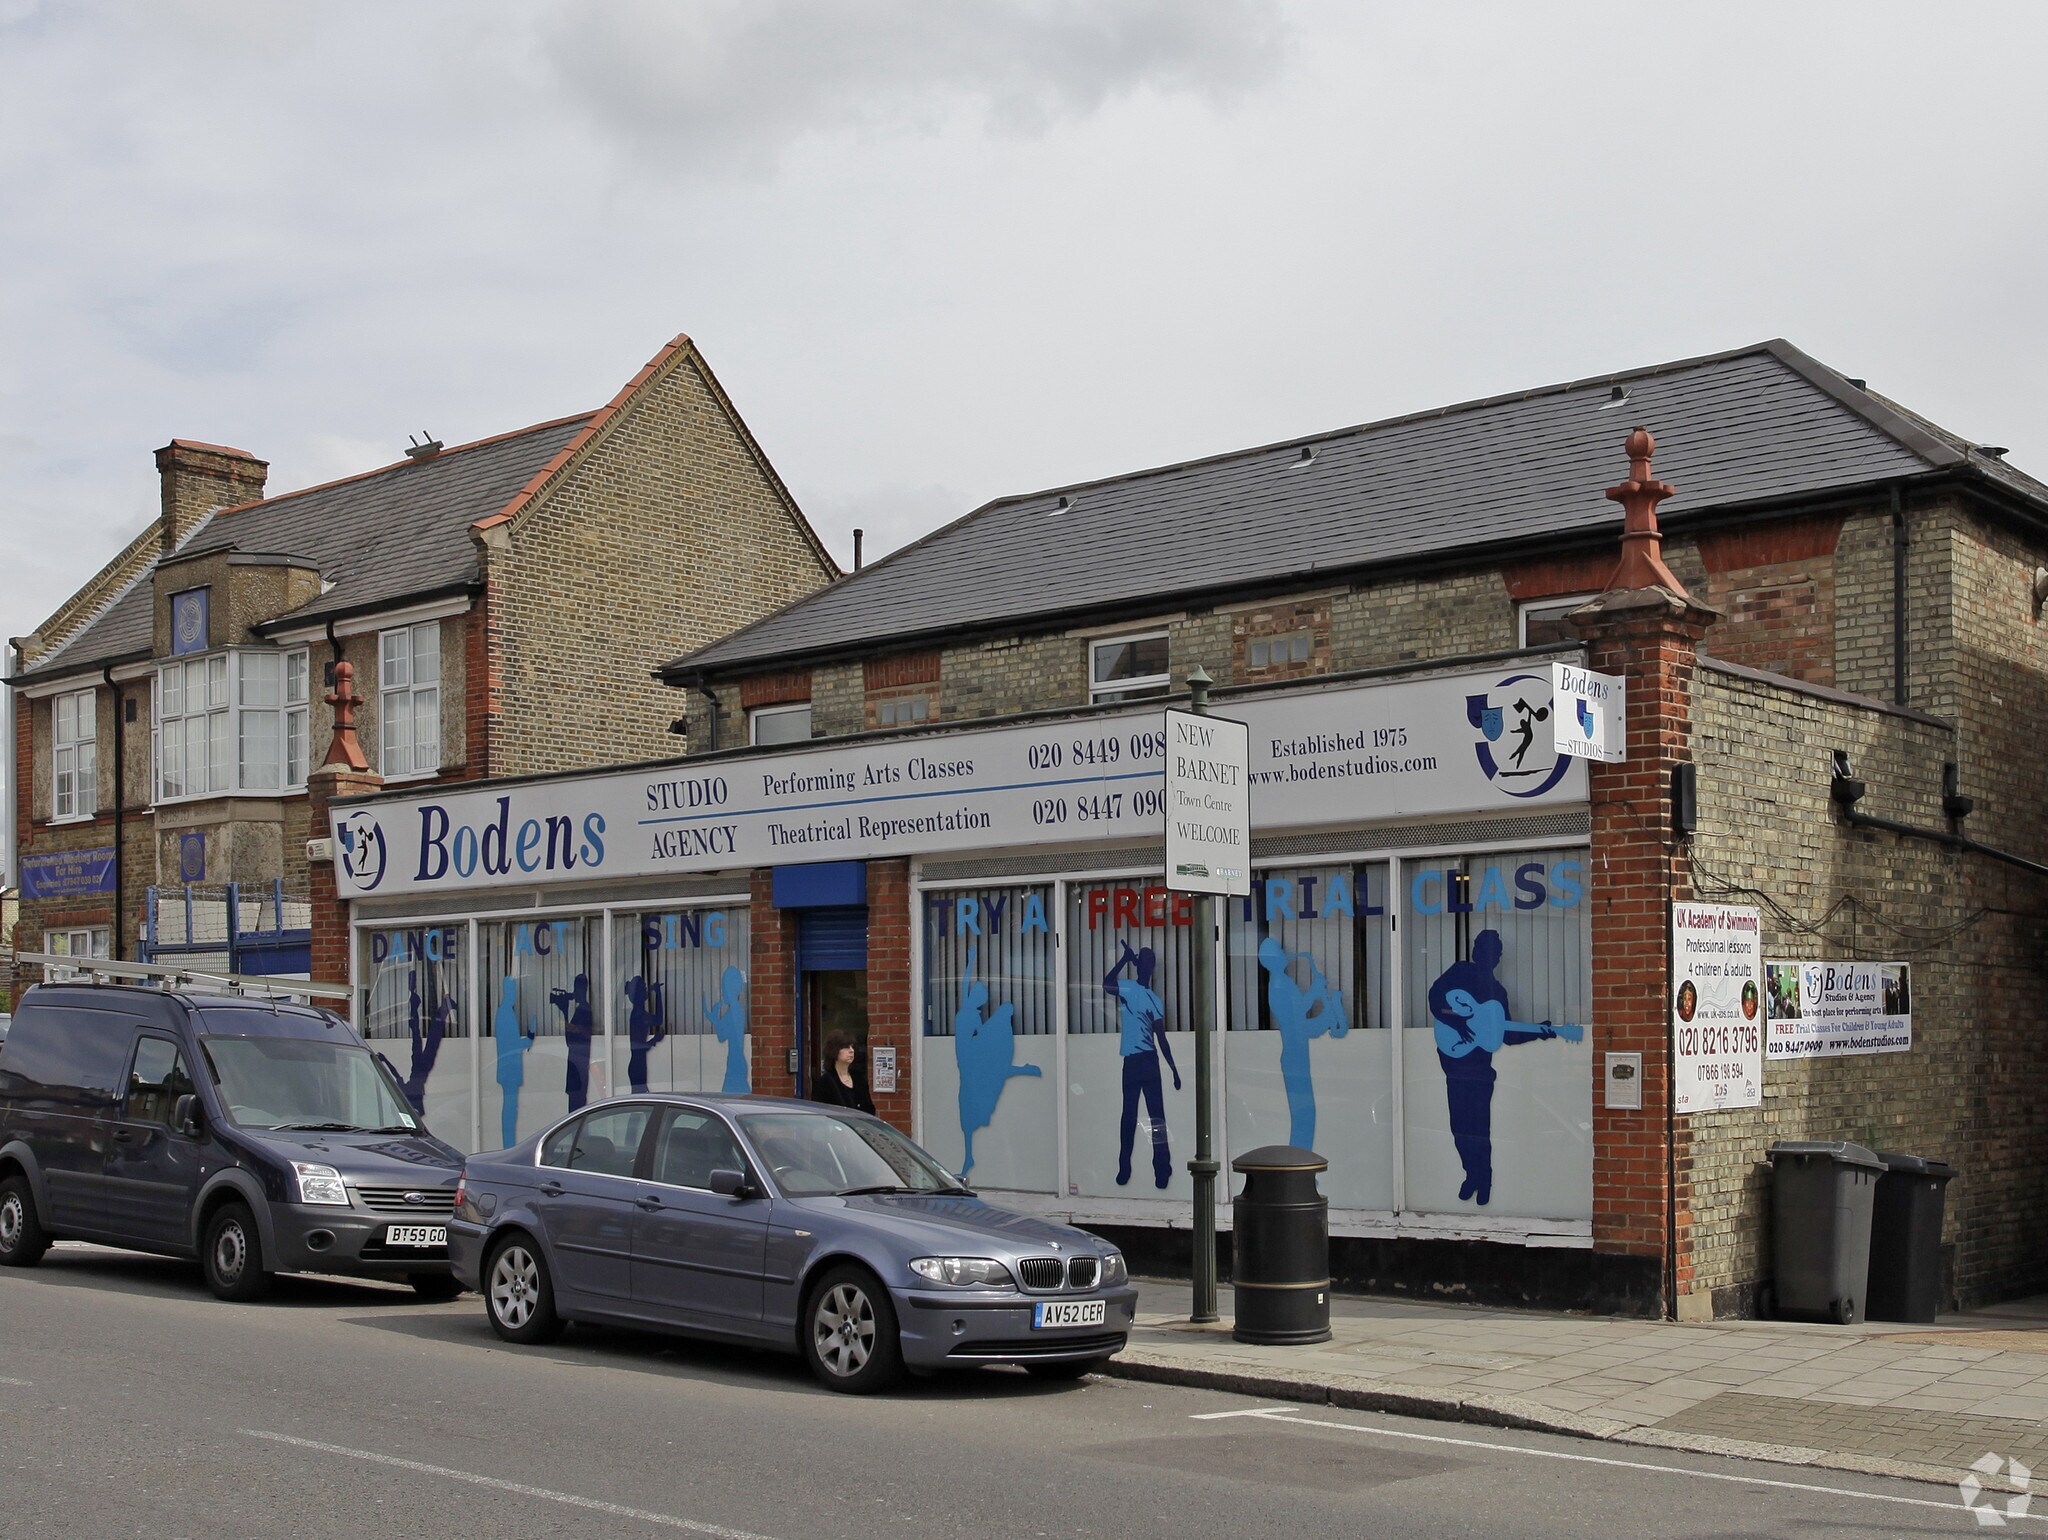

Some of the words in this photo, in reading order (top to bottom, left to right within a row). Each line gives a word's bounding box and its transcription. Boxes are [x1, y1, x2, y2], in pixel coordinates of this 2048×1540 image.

[1560, 667, 1609, 700] Bodens
[1176, 722, 1215, 748] NEW
[1271, 730, 1365, 759] Established
[1372, 727, 1408, 748] 1975
[1567, 739, 1603, 759] STUDIOS
[1028, 744, 1063, 771] 020
[1072, 736, 1120, 767] 8449
[1130, 731, 1165, 760] 098
[763, 768, 856, 796] Performing
[862, 763, 900, 786] Arts
[908, 757, 974, 781] Classes
[1176, 756, 1240, 786] BARNET
[1248, 754, 1438, 786] www.bodenstudios.com
[646, 776, 728, 811] STUDIO
[1032, 799, 1067, 826] 020
[1077, 793, 1123, 822] 8447
[1133, 788, 1165, 817] 090
[1176, 790, 1201, 807] Town
[1204, 793, 1232, 812] Centre
[413, 796, 606, 882] Bodens
[767, 818, 852, 846] Theatrical
[857, 807, 991, 840] Representation
[1176, 821, 1241, 846] WELCOME
[651, 825, 739, 860] AGENCY
[931, 895, 1007, 937] TRY
[1021, 894, 1049, 934] A
[1088, 886, 1195, 930] FREE
[1411, 860, 1584, 916] CLASS
[645, 911, 726, 951] SING
[1677, 908, 1687, 928] UK
[1688, 909, 1717, 934] Academy
[1718, 910, 1725, 930] of
[1726, 911, 1758, 936] Swimming
[372, 928, 456, 963] DANCE
[514, 921, 569, 956] ACT
[1686, 938, 1726, 953] Professional
[1727, 940, 1752, 954] lessons
[1688, 962, 1693, 976] 4
[1694, 962, 1722, 977] children
[1724, 962, 1729, 977] &
[1730, 963, 1752, 977] adults
[1824, 966, 1877, 991] Bodens
[1802, 1008, 1811, 1017] the
[1811, 1007, 1822, 1016] best
[1822, 1007, 1836, 1018] place
[1836, 1007, 1844, 1016] for
[1845, 1006, 1872, 1018] performing
[1872, 1007, 1882, 1015] arts
[1825, 992, 1847, 1002] Studios
[1848, 992, 1854, 1001] &
[1854, 993, 1876, 1003] Agency
[1679, 1027, 1699, 1056] 020
[1702, 1026, 1729, 1055] 8216
[1732, 1025, 1758, 1054] 3796
[1775, 1024, 1794, 1035] FREE
[1796, 1023, 1811, 1034] Trial
[1811, 1022, 1830, 1033] Classes
[1831, 1022, 1841, 1033] For
[1842, 1021, 1864, 1032] Children
[1870, 1020, 1887, 1032] Young
[1887, 1020, 1904, 1030] Adults
[1769, 1043, 1782, 1053] 020
[1829, 1035, 1909, 1050] www.bodenstudios.com
[1697, 1063, 1719, 1081] 07866
[1731, 1062, 1743, 1079] 594
[1677, 1094, 1689, 1104] sta
[392, 1228, 427, 1242] BT59
[429, 1228, 446, 1242] GO
[1045, 1305, 1080, 1323] AV52
[1082, 1304, 1103, 1322] CER
